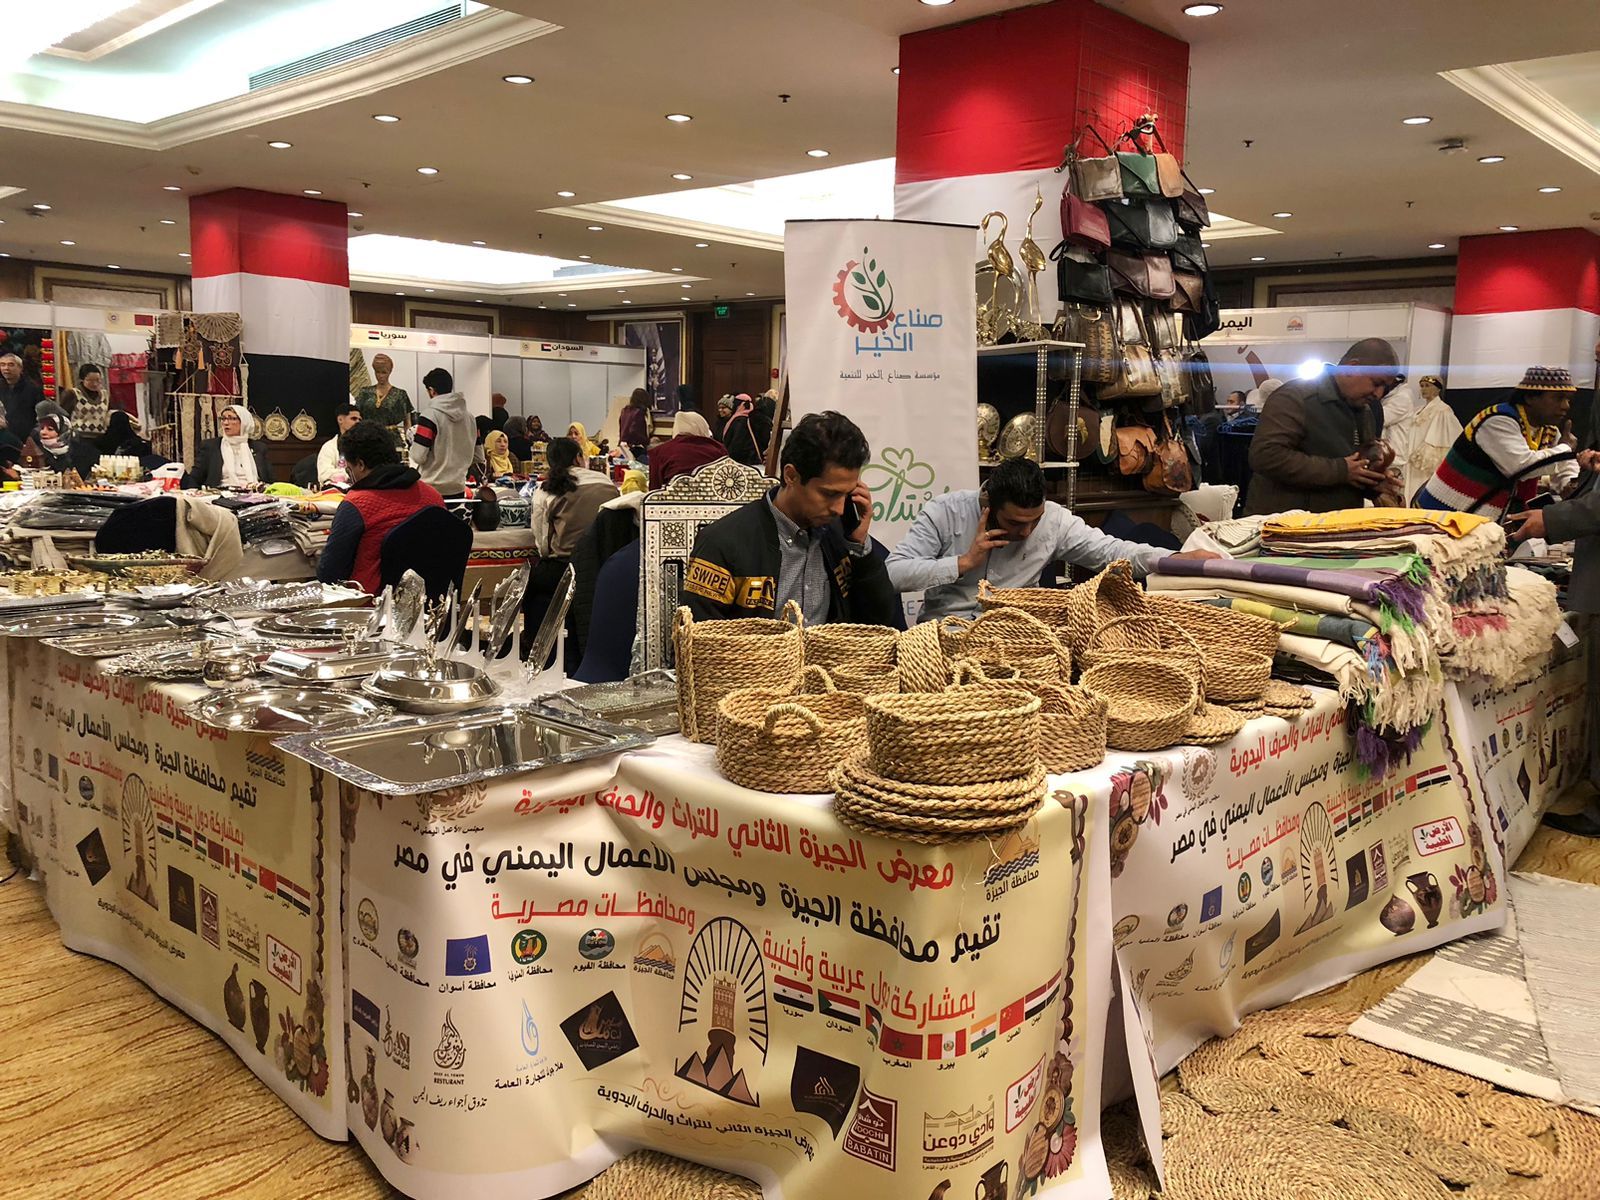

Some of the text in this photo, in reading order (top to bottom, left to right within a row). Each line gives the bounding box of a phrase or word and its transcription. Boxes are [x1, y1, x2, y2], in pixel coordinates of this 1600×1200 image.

[380, 331, 407, 339] سوريا
[893, 308, 943, 340] صناع
[855, 331, 913, 357] الخير
[914, 370, 940, 381] مؤسسة
[692, 566, 728, 596] SWIPE
[78, 714, 112, 742] الأعمال
[1269, 725, 1299, 760] والحرف
[1302, 712, 1325, 743] للتراث
[114, 730, 149, 764] ومجلس
[155, 742, 181, 776] الجيزة
[1229, 736, 1265, 777] اليدوية
[184, 755, 226, 793] محافظة
[1294, 761, 1329, 796] ومجلس
[231, 781, 257, 808] تقيم
[1257, 770, 1294, 815] الأعمال
[672, 797, 718, 839] للتراث
[1220, 792, 1255, 841] اليمني
[1262, 814, 1300, 848] ومحافظات
[1430, 821, 1454, 838] الأرض
[727, 817, 790, 857] الثاني
[1170, 829, 1195, 864] مصر
[1200, 811, 1217, 854] في
[1425, 836, 1454, 850] الطيبة
[799, 828, 866, 874] الجيزة
[1227, 836, 1260, 870] مصرية
[877, 849, 954, 892] معرض
[986, 870, 1039, 902] محافظة الجيزة
[394, 841, 1000, 963] تقيم محافظة الجيزة ومجلس الأعمال اليمني في مصر
[491, 891, 696, 935] ومحافظات مصرية
[573, 960, 626, 972] محافظة الفيوم
[762, 930, 814, 982] وأجنبية
[526, 967, 553, 976] محافظة
[819, 951, 865, 993] عربية
[438, 980, 497, 994] محافظة أسوان
[782, 1006, 804, 1018] سوريا
[891, 986, 976, 1030] بمشاركة
[826, 1020, 854, 1033] السودان
[882, 1057, 912, 1069] المغرب
[937, 1062, 956, 1071] بيرو
[413, 1086, 428, 1104] اليمن
[495, 1078, 522, 1089] العامة
[597, 1085, 638, 1108] اليدوية
[429, 1095, 447, 1107] ريف
[468, 1097, 487, 1111] تذوق
[637, 1101, 674, 1125] والحرف
[676, 1113, 712, 1129] للتراث
[716, 1124, 751, 1133] الثاني
[755, 1126, 792, 1139] الجيزة
[969, 1113, 994, 1146] وادي
[847, 1139, 889, 1163] BABATIN
[922, 1133, 966, 1151] دوعن
